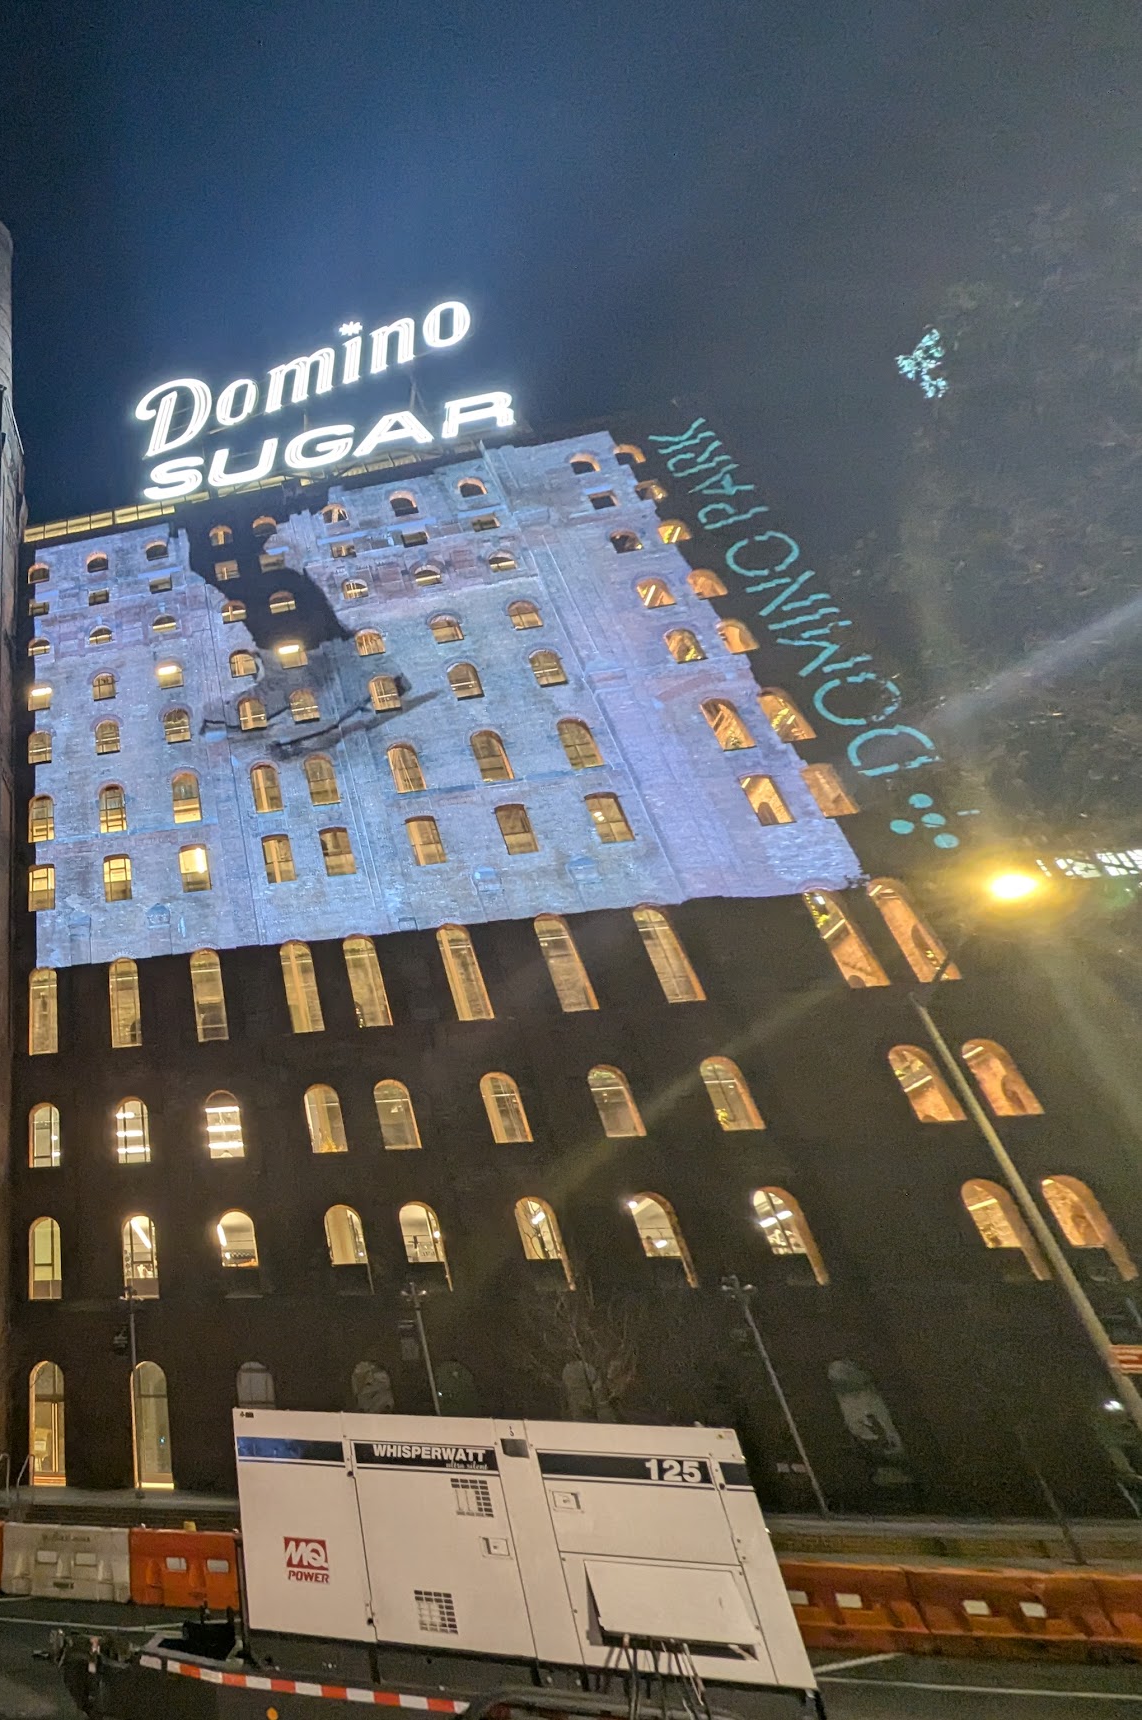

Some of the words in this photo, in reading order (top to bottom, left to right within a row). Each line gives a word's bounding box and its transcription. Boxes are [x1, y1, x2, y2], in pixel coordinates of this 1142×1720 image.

[135, 300, 471, 459] Domino
[143, 390, 516, 500] SUGAR
[648, 417, 769, 530] PARK
[725, 530, 942, 777] DOMINO
[372, 1443, 486, 1462] WHISPERWATT
[644, 1458, 702, 1484] 125
[285, 1540, 329, 1568] MQ
[288, 1569, 330, 1584] POWER
